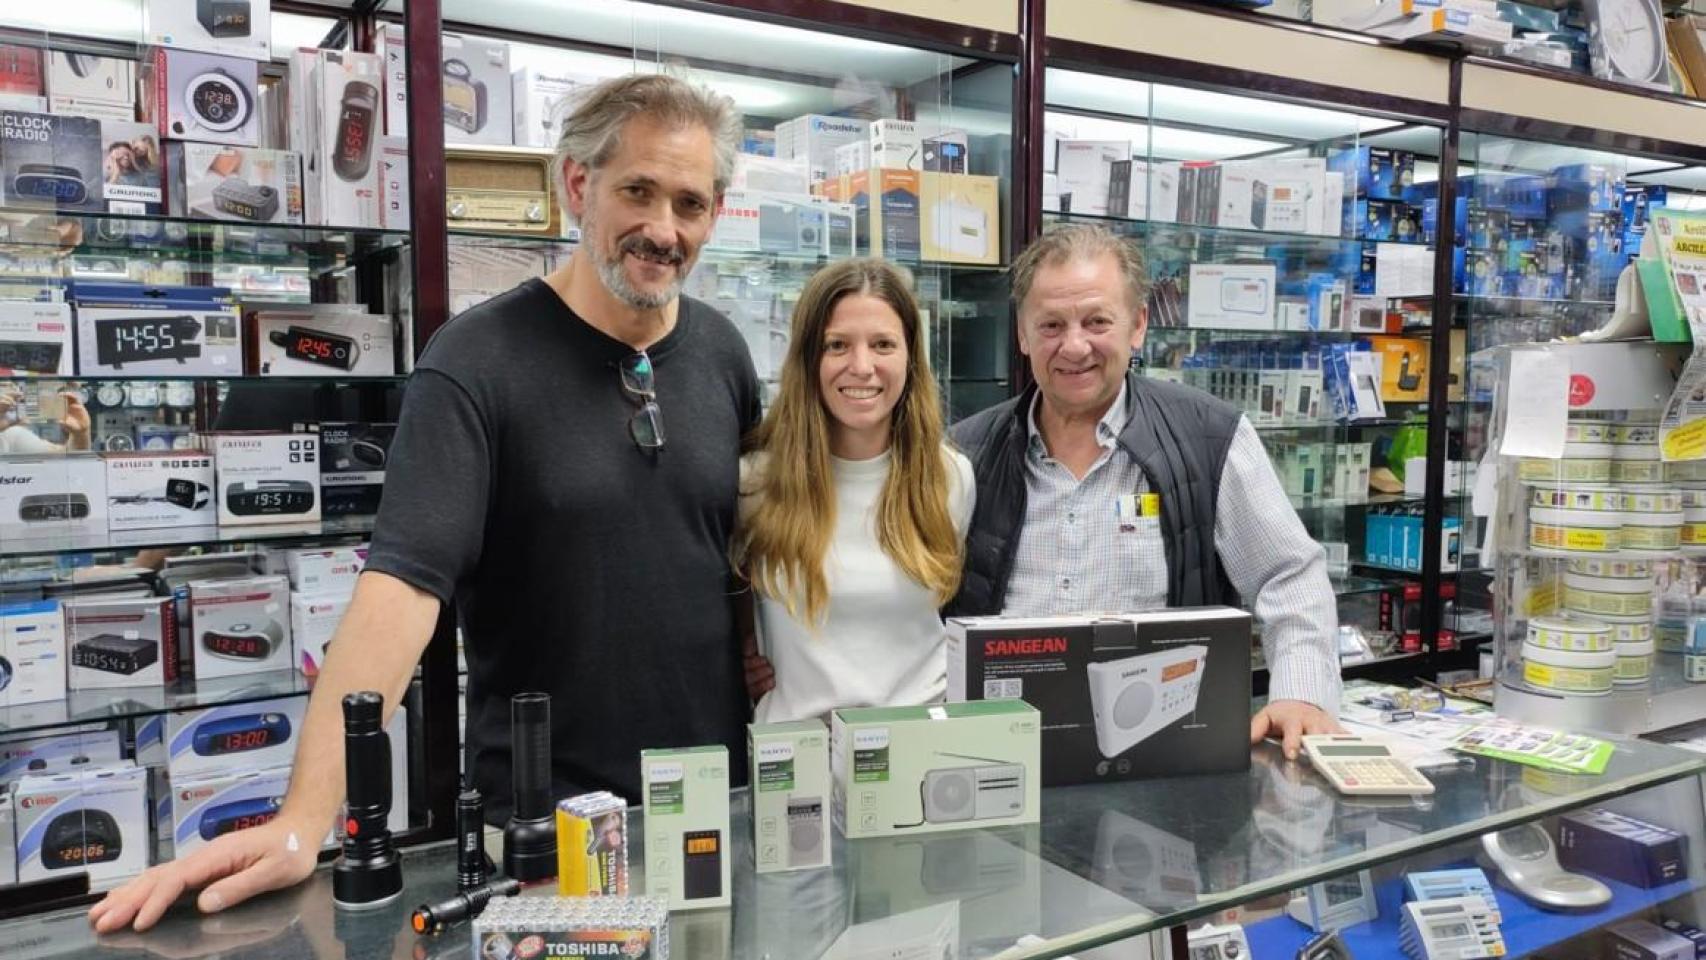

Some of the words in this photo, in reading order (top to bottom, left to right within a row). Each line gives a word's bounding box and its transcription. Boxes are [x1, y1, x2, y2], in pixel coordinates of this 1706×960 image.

[4, 115, 52, 130] CLOCK
[4, 127, 49, 142] RADIO
[115, 324, 175, 351] 14:55
[297, 338, 332, 358] 12:45
[984, 638, 1067, 656] SANGEAN
[225, 730, 268, 749] 13:00
[608, 850, 617, 897] TOSHIB
[546, 943, 620, 955] TOSHIBA
